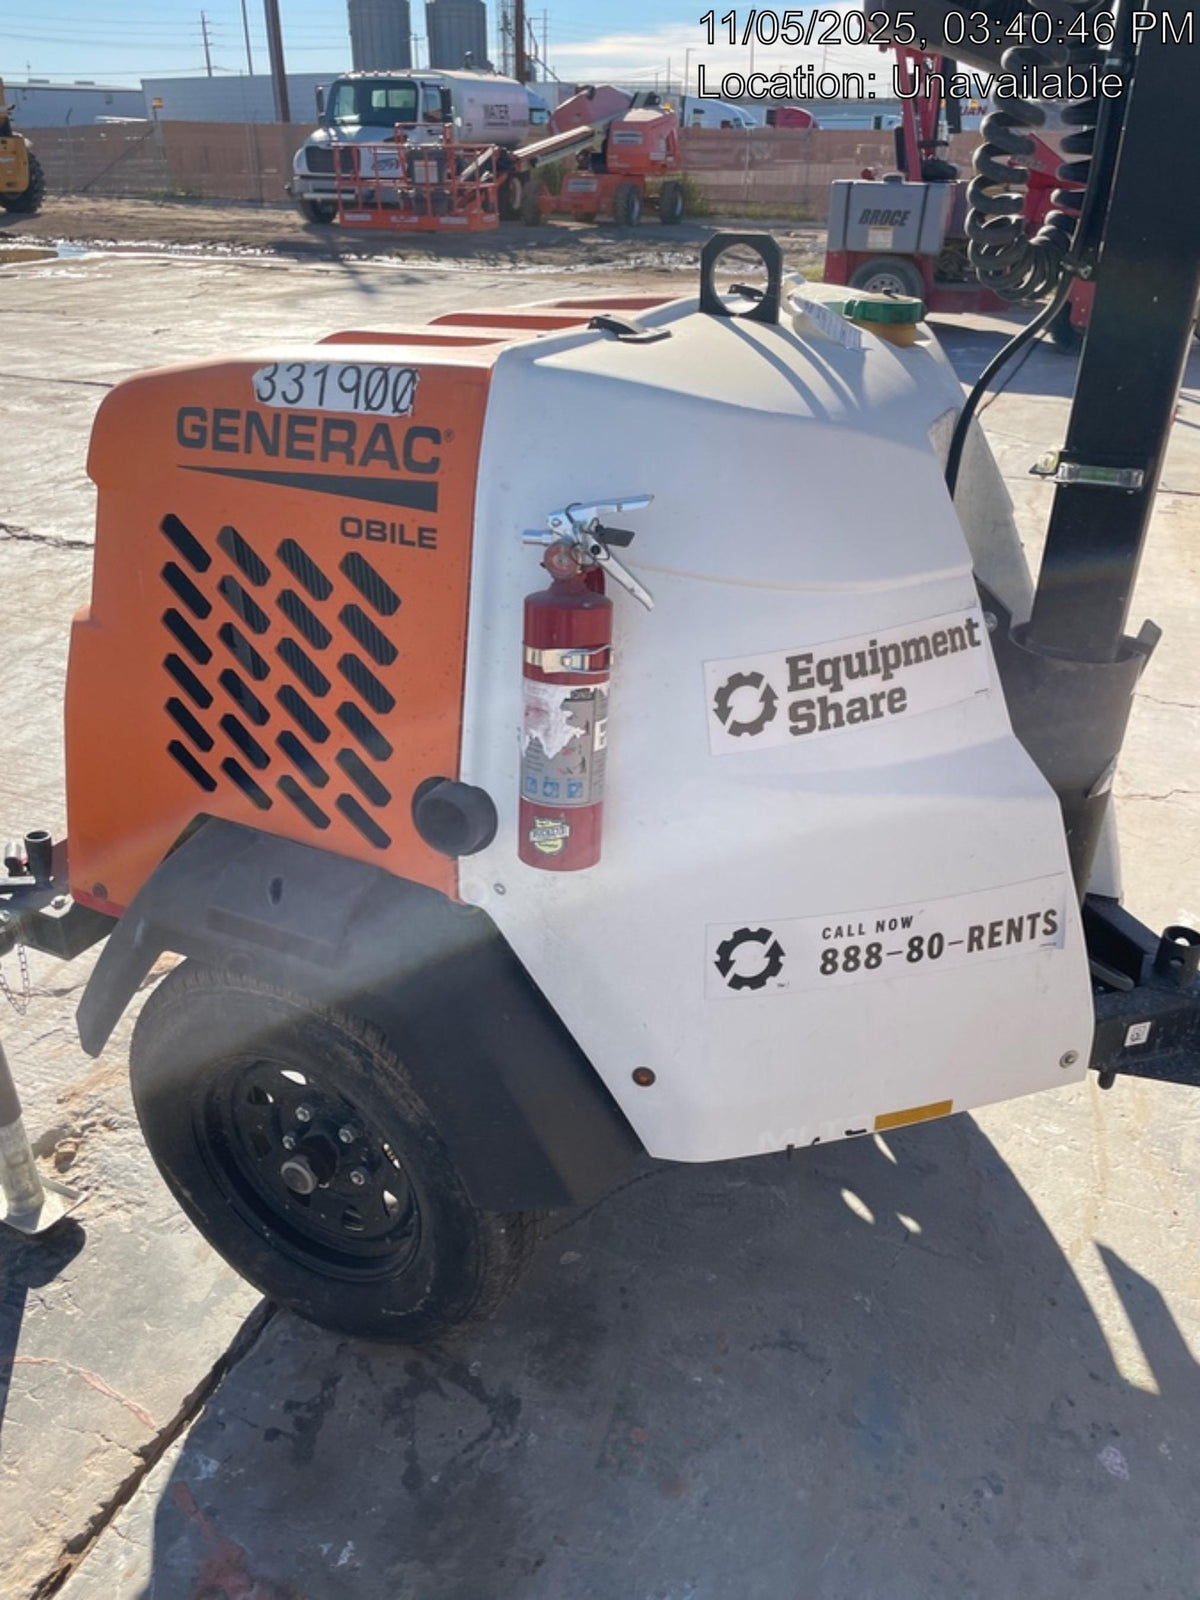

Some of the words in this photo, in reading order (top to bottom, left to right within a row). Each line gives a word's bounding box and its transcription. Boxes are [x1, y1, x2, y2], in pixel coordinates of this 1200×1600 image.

[483, 104, 510, 120] WATER
[858, 208, 911, 226] BROCE
[257, 362, 418, 413] 331900
[176, 406, 442, 475] GENERAC
[340, 516, 438, 549] OBILE
[785, 617, 981, 693] Equipment
[789, 686, 908, 737] Share
[819, 908, 1059, 976] 888-80-RENTS
[821, 919, 867, 940] CALL
[875, 914, 915, 932] NOW
